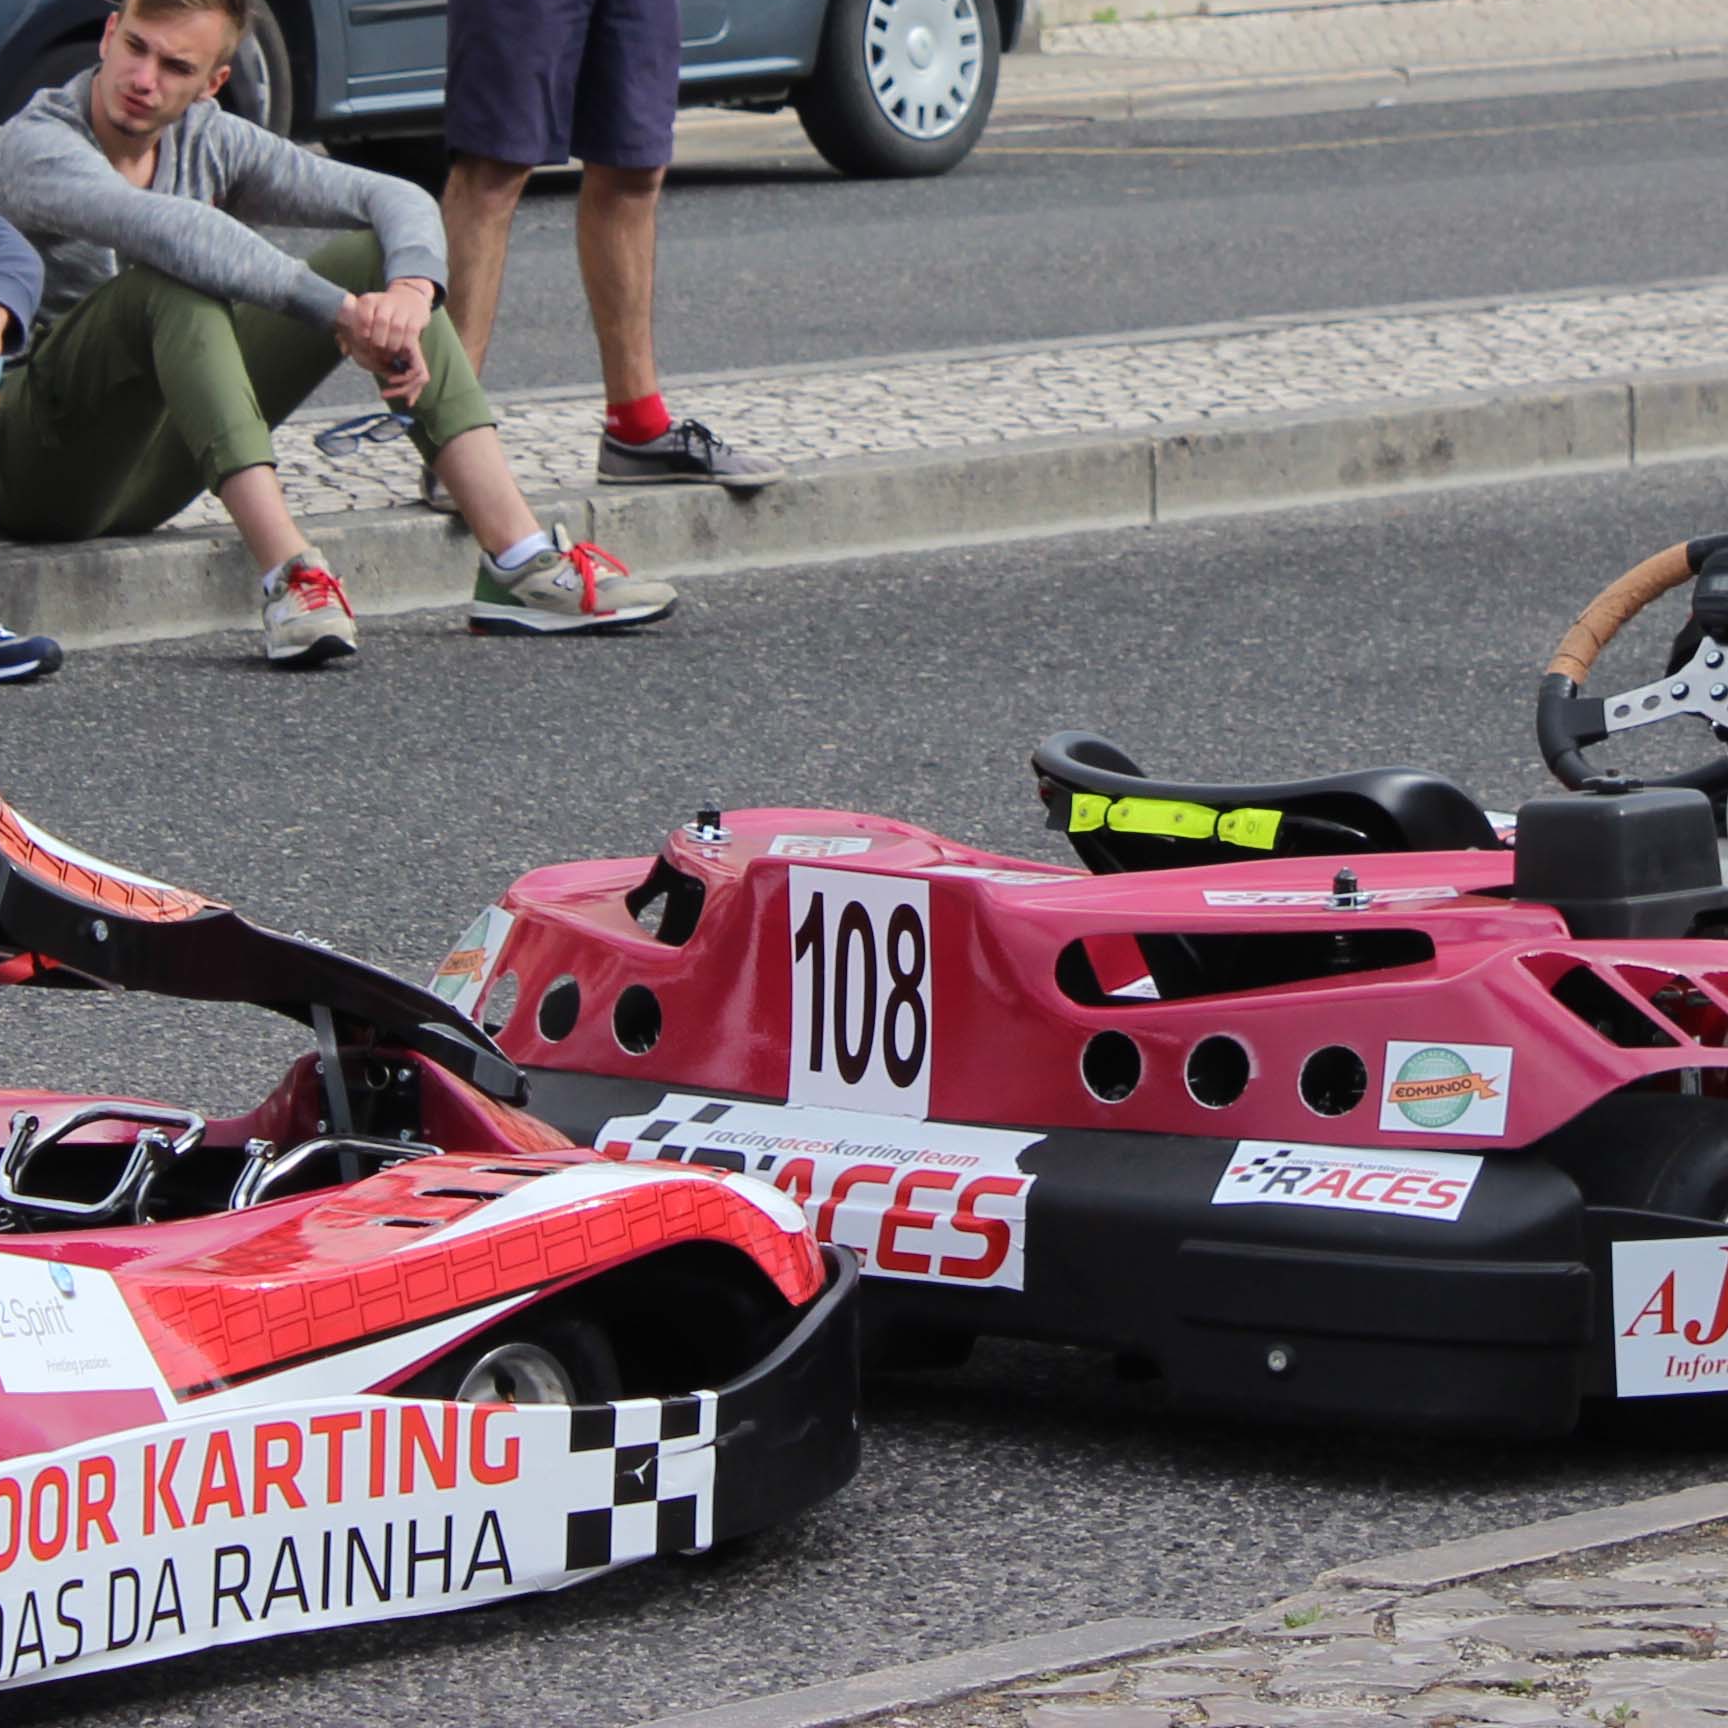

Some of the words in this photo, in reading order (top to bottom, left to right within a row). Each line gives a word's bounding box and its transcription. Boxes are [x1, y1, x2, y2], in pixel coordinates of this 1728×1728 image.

[793, 891, 929, 1088] 108
[705, 1128, 981, 1169] racingaceskartingteam
[1395, 1078, 1472, 1098] EDMUNDO
[141, 1400, 522, 1536] KARTING
[106, 1559, 188, 1653] DA
[211, 1508, 514, 1629] RAINHA
